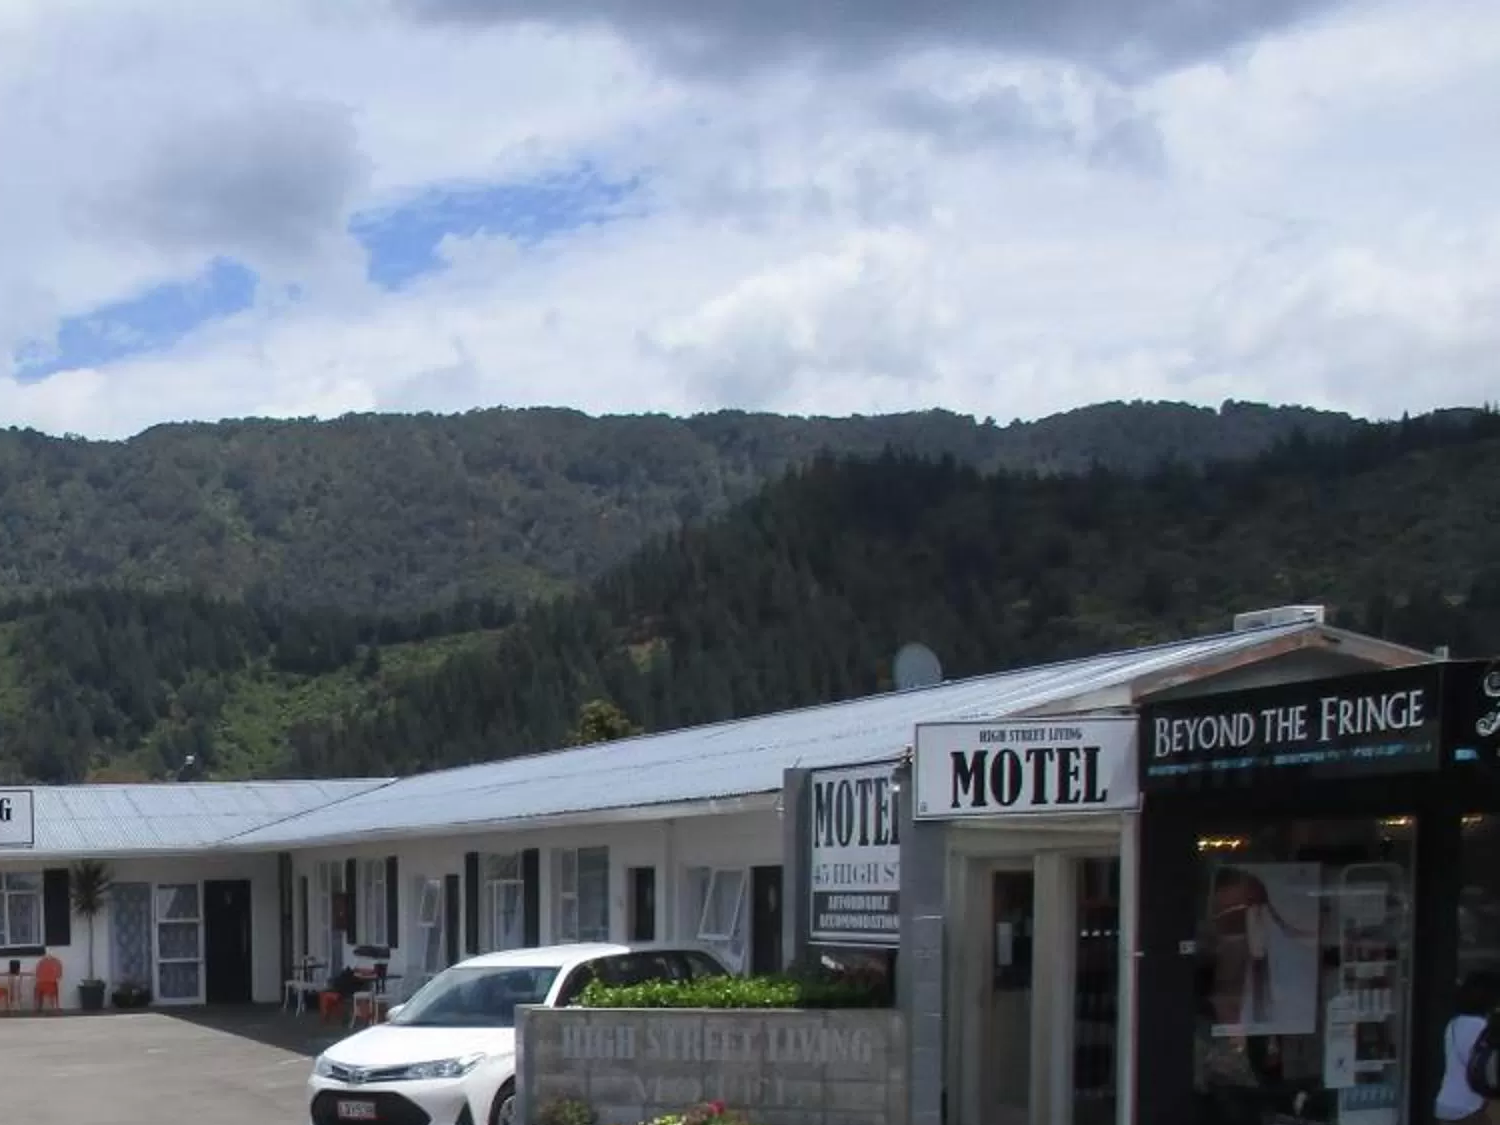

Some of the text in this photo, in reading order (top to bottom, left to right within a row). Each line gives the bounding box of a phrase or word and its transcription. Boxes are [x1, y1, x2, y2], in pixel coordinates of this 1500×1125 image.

[979, 727, 1082, 743] HIGH STREET LIVING
[1154, 712, 1255, 758] BEYOND
[1261, 704, 1308, 743] THE
[1319, 689, 1425, 742] FRINGE
[950, 746, 1108, 808] MOTEL
[833, 863, 878, 885] HIGH
[562, 1024, 873, 1064] HIGH STREET LIVING
